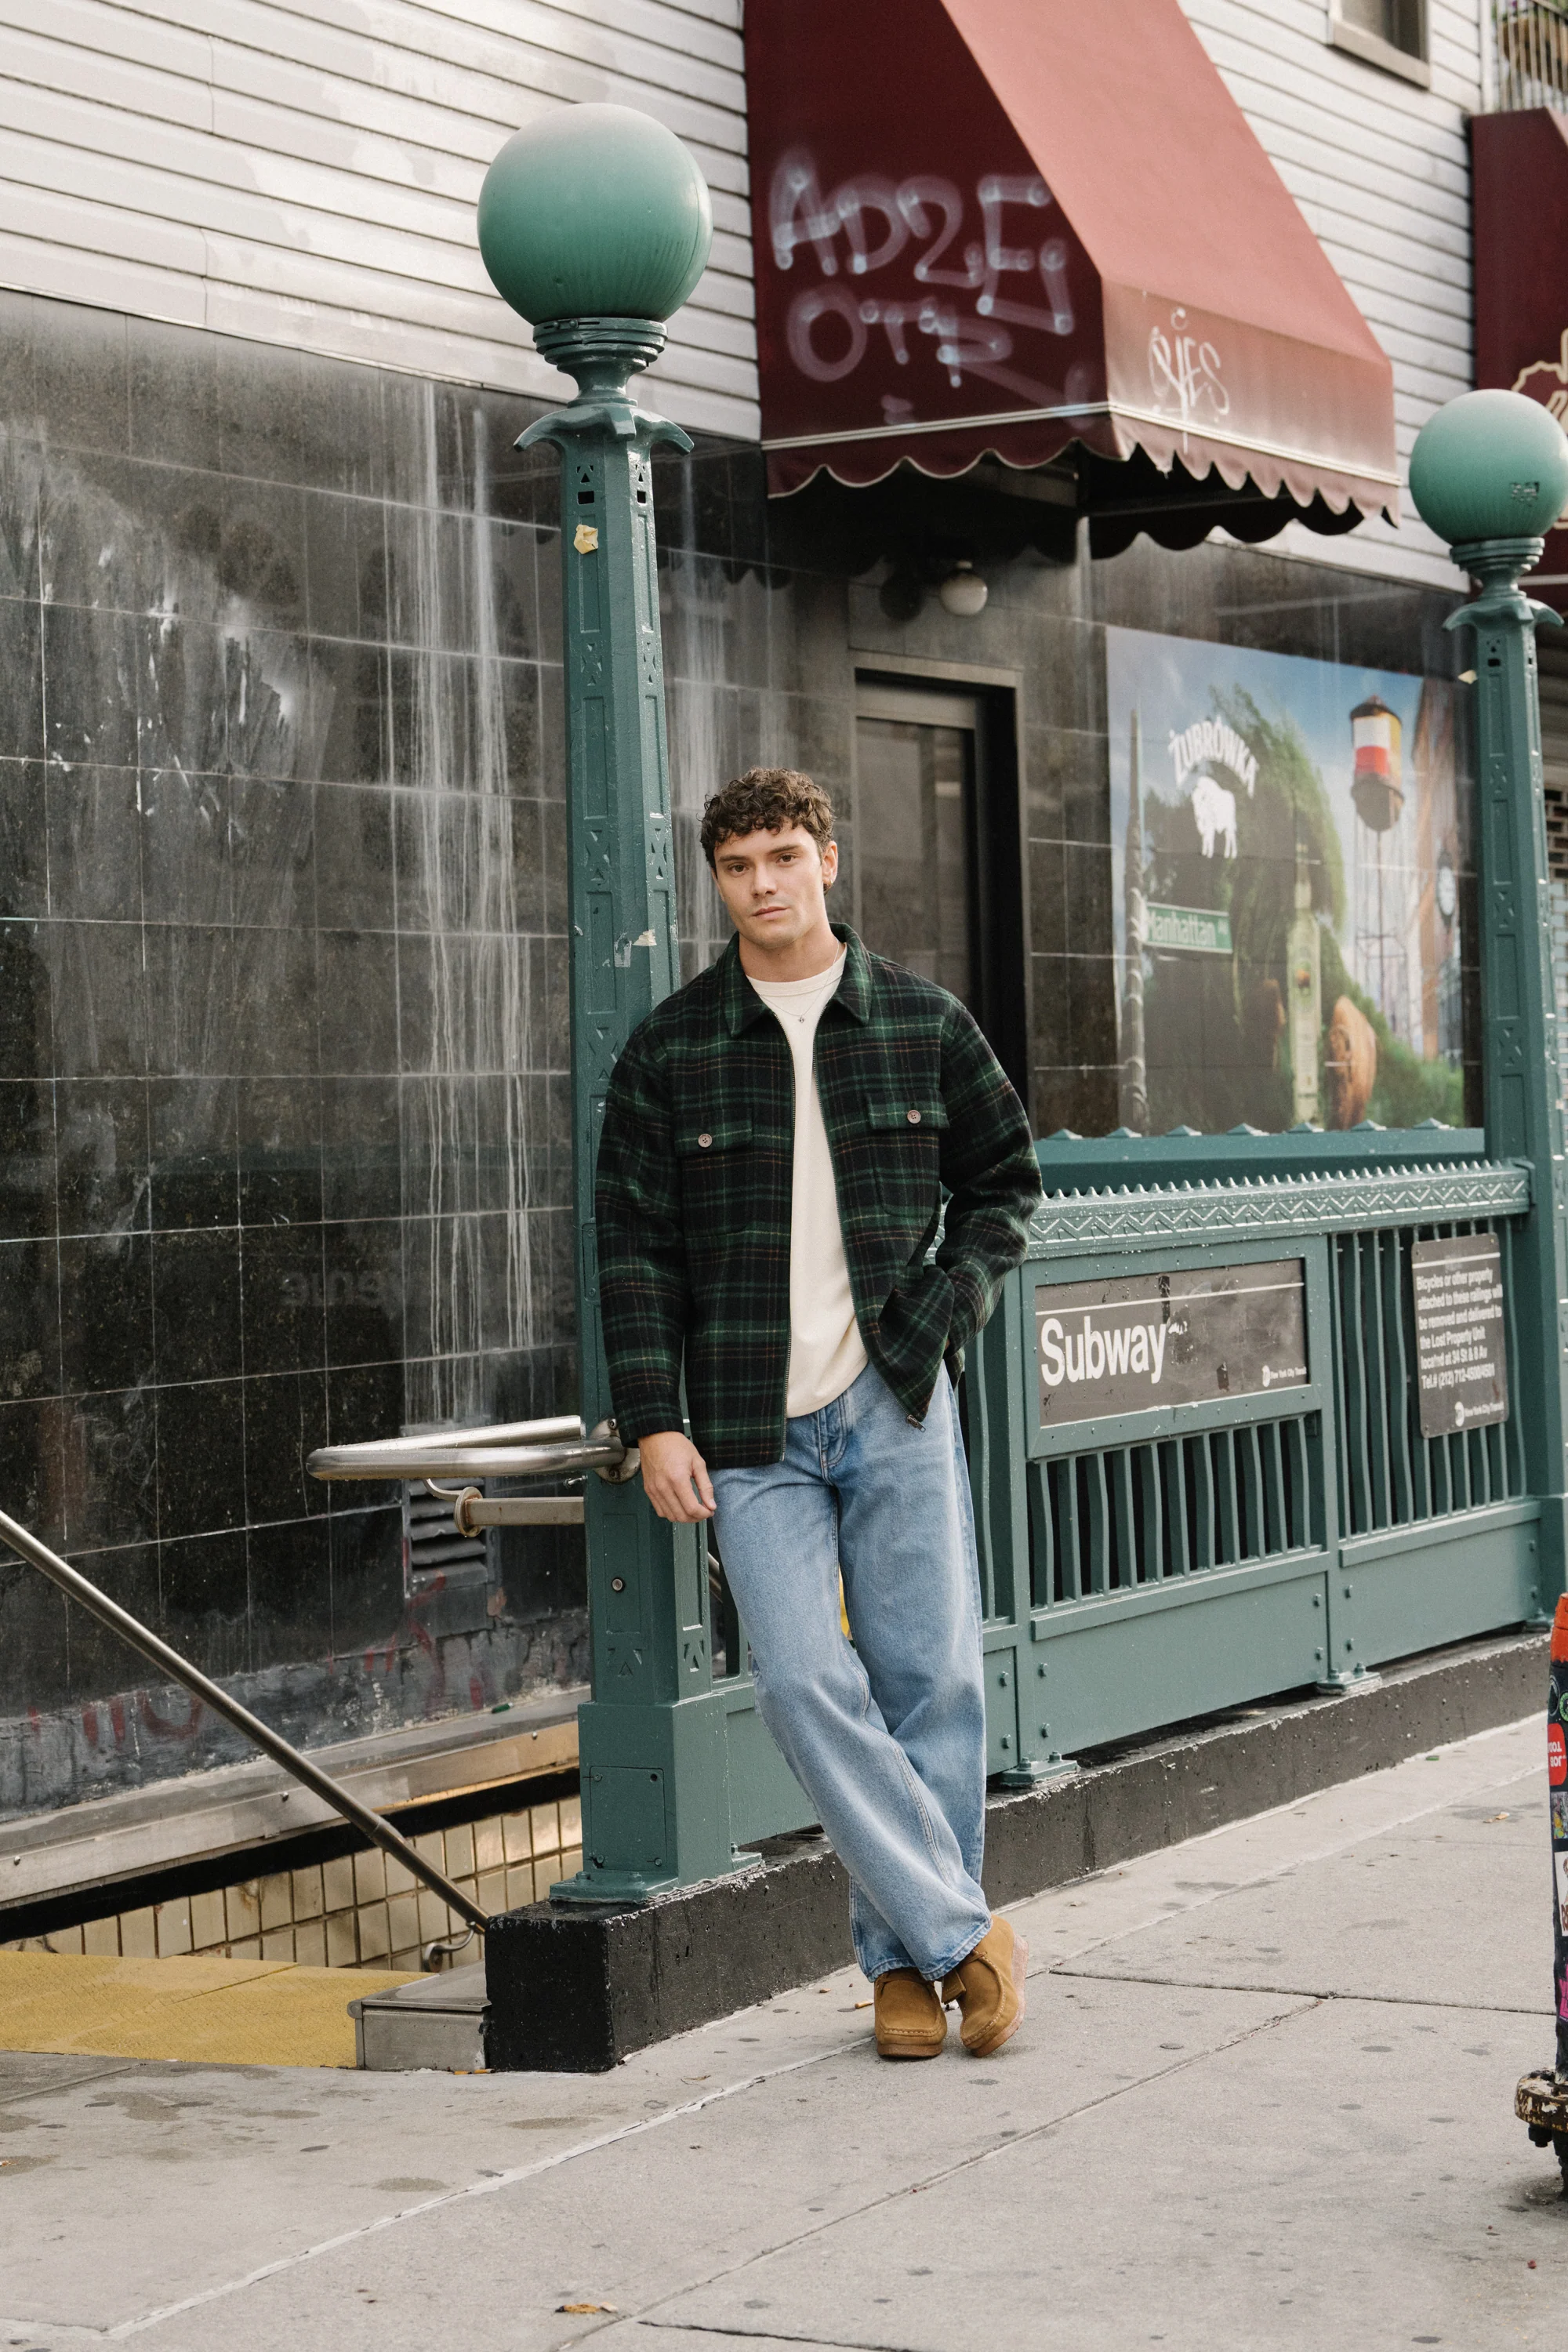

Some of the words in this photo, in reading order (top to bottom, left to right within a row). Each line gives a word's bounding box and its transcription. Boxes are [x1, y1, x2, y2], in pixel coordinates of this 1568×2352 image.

[1416, 1274, 1443, 1293] Bicycles
[1444, 1275, 1451, 1287] or
[1452, 1271, 1468, 1286] other
[1468, 1267, 1493, 1287] property
[1417, 1293, 1445, 1310] attached
[1446, 1292, 1453, 1306] to
[1453, 1290, 1469, 1305] these
[1470, 1287, 1492, 1304] railings
[1492, 1283, 1503, 1298] will
[1418, 1316, 1428, 1330] be
[1428, 1311, 1455, 1329] removed
[1456, 1308, 1468, 1324] and
[1468, 1304, 1495, 1322] delivered
[1495, 1304, 1502, 1318] to
[1420, 1335, 1431, 1350] the
[1431, 1333, 1446, 1348] Lost
[1446, 1328, 1472, 1347] Property
[1472, 1325, 1486, 1341] Unit
[1041, 1316, 1166, 1386] Subway
[1445, 1351, 1452, 1366] at
[1452, 1348, 1460, 1364] 34
[1460, 1348, 1468, 1363] St
